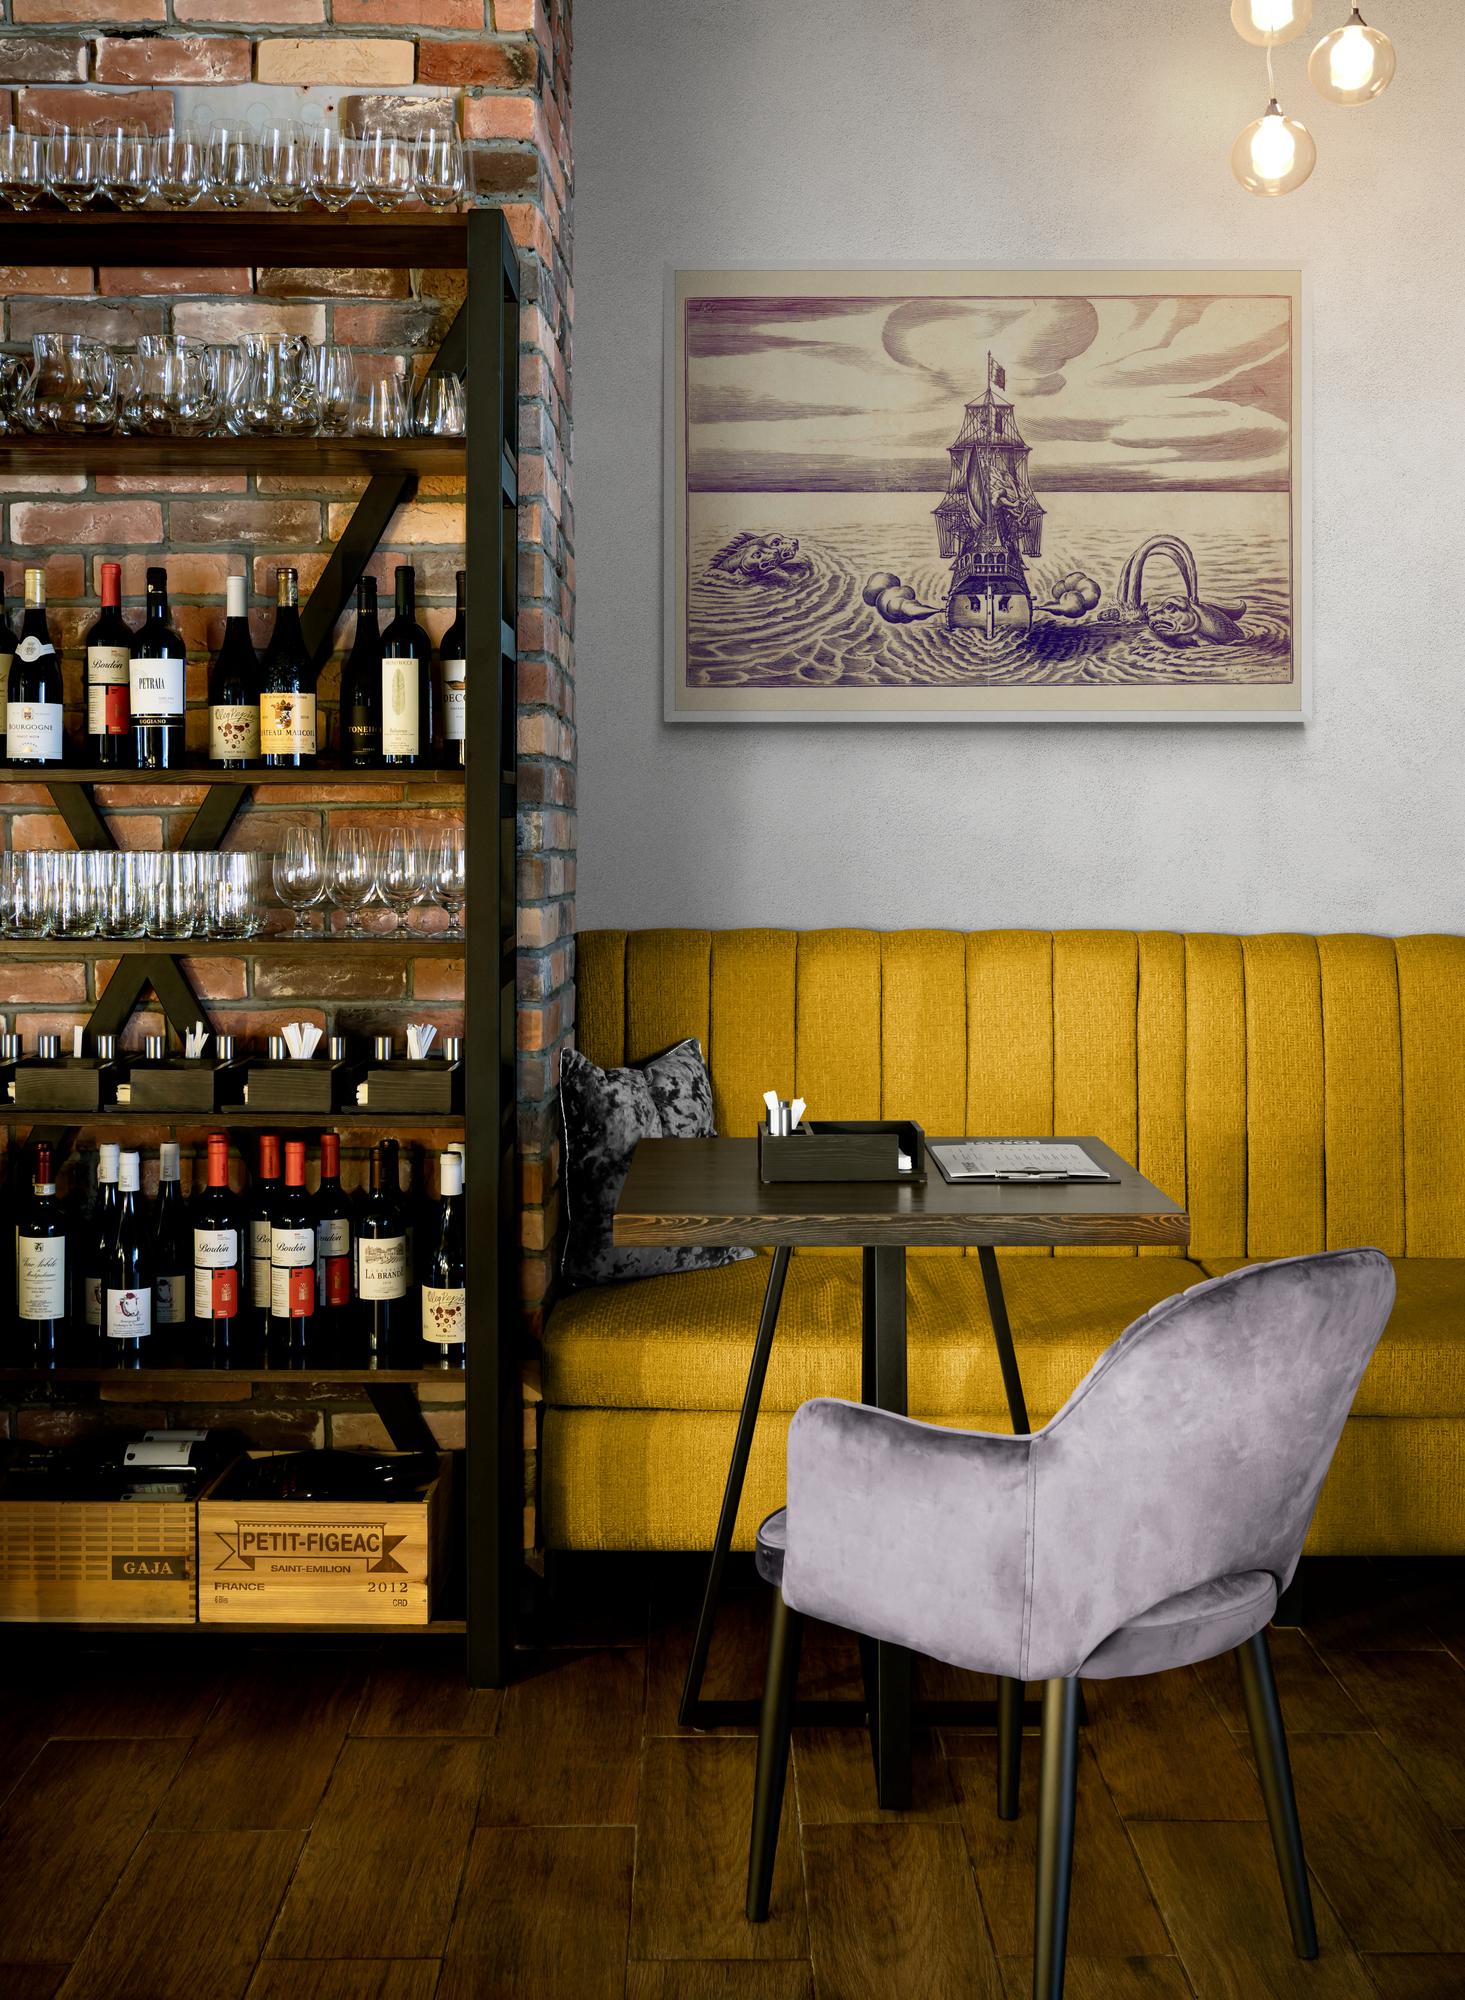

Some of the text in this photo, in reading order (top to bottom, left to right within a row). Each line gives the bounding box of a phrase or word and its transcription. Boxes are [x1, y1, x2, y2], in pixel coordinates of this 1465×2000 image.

[138, 677, 166, 690] PETRAIA
[8, 723, 53, 731] BOURGOGNE
[199, 1243, 230, 1253] Bordón
[276, 1241, 306, 1252] Bordón
[242, 1531, 380, 1553] PETIT-FIGEAC
[123, 1561, 174, 1575] GAJA
[270, 1564, 351, 1574] SAINT-EMILION
[214, 1581, 265, 1591] FRANCE
[367, 1582, 408, 1593] 2012
[392, 1599, 408, 1607] CRD
